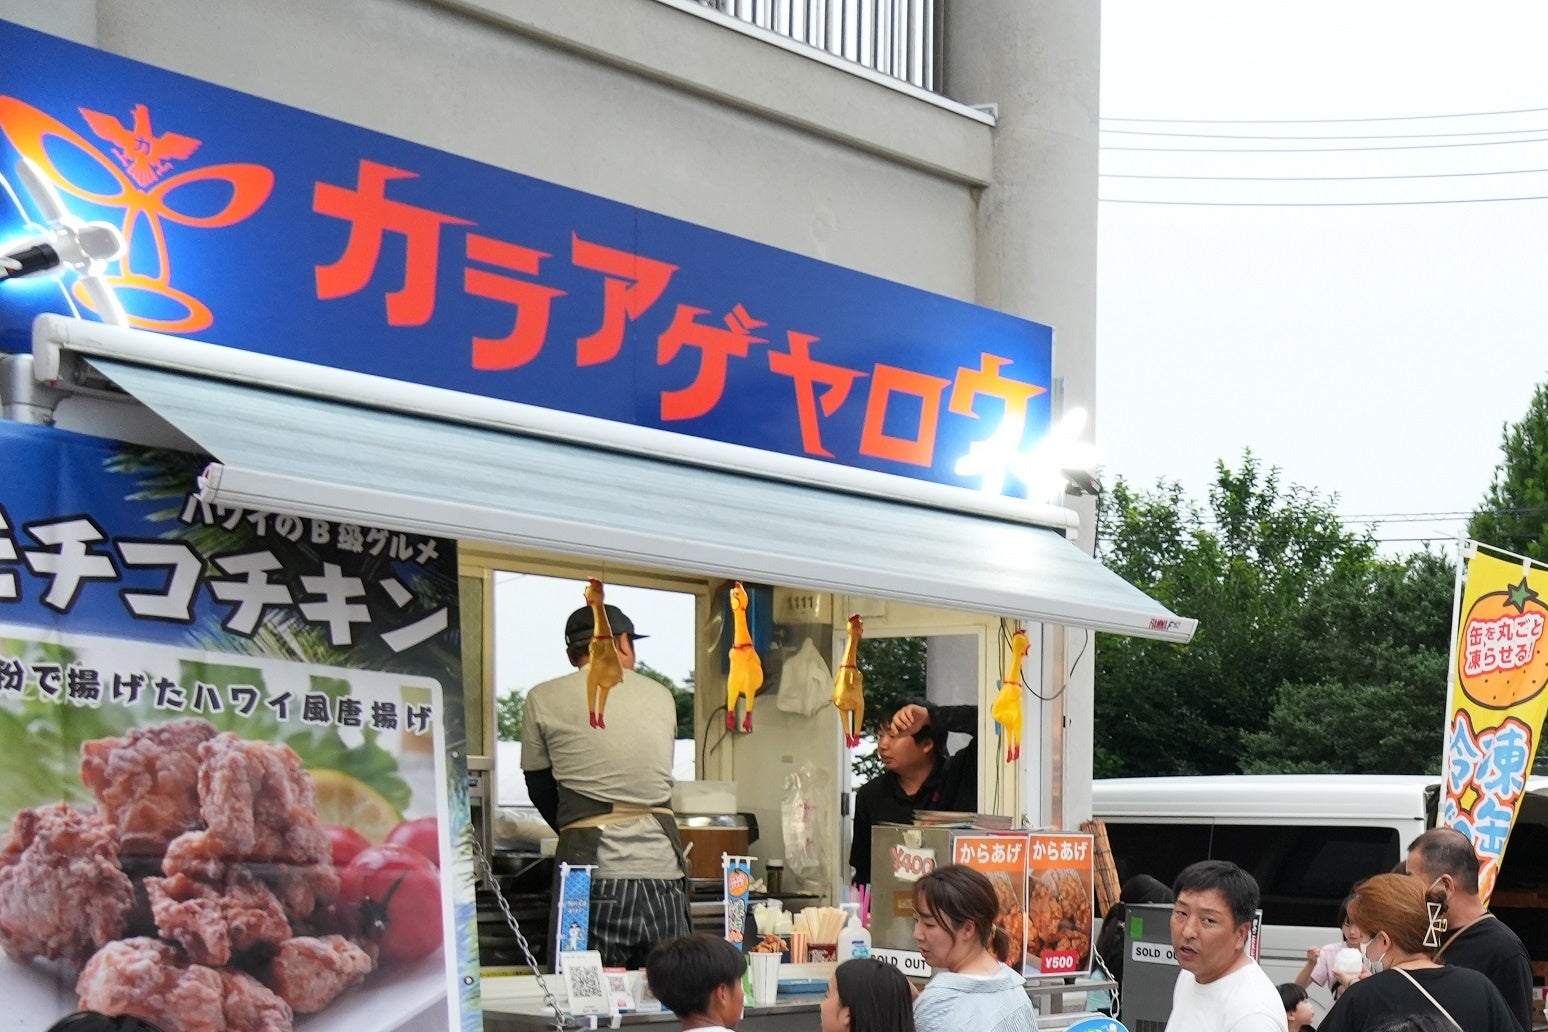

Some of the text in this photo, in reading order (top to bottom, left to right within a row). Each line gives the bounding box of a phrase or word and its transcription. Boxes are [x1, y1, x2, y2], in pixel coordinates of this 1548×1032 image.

[311, 158, 1048, 477] カラアゲヤロウ
[182, 492, 440, 565] ハワイのB級グルメ
[0, 508, 449, 653] チコチキン
[1470, 618, 1541, 646] 缶を丸ごと
[0, 658, 434, 734] 粉で揚げたハワイ風唐揚げ
[892, 847, 934, 873] ¥400
[960, 843, 1023, 864] からあげ
[1033, 841, 1089, 860] からあげ
[905, 958, 927, 970] OUT
[1045, 955, 1074, 969] ¥500
[1136, 947, 1161, 958] SOLD
